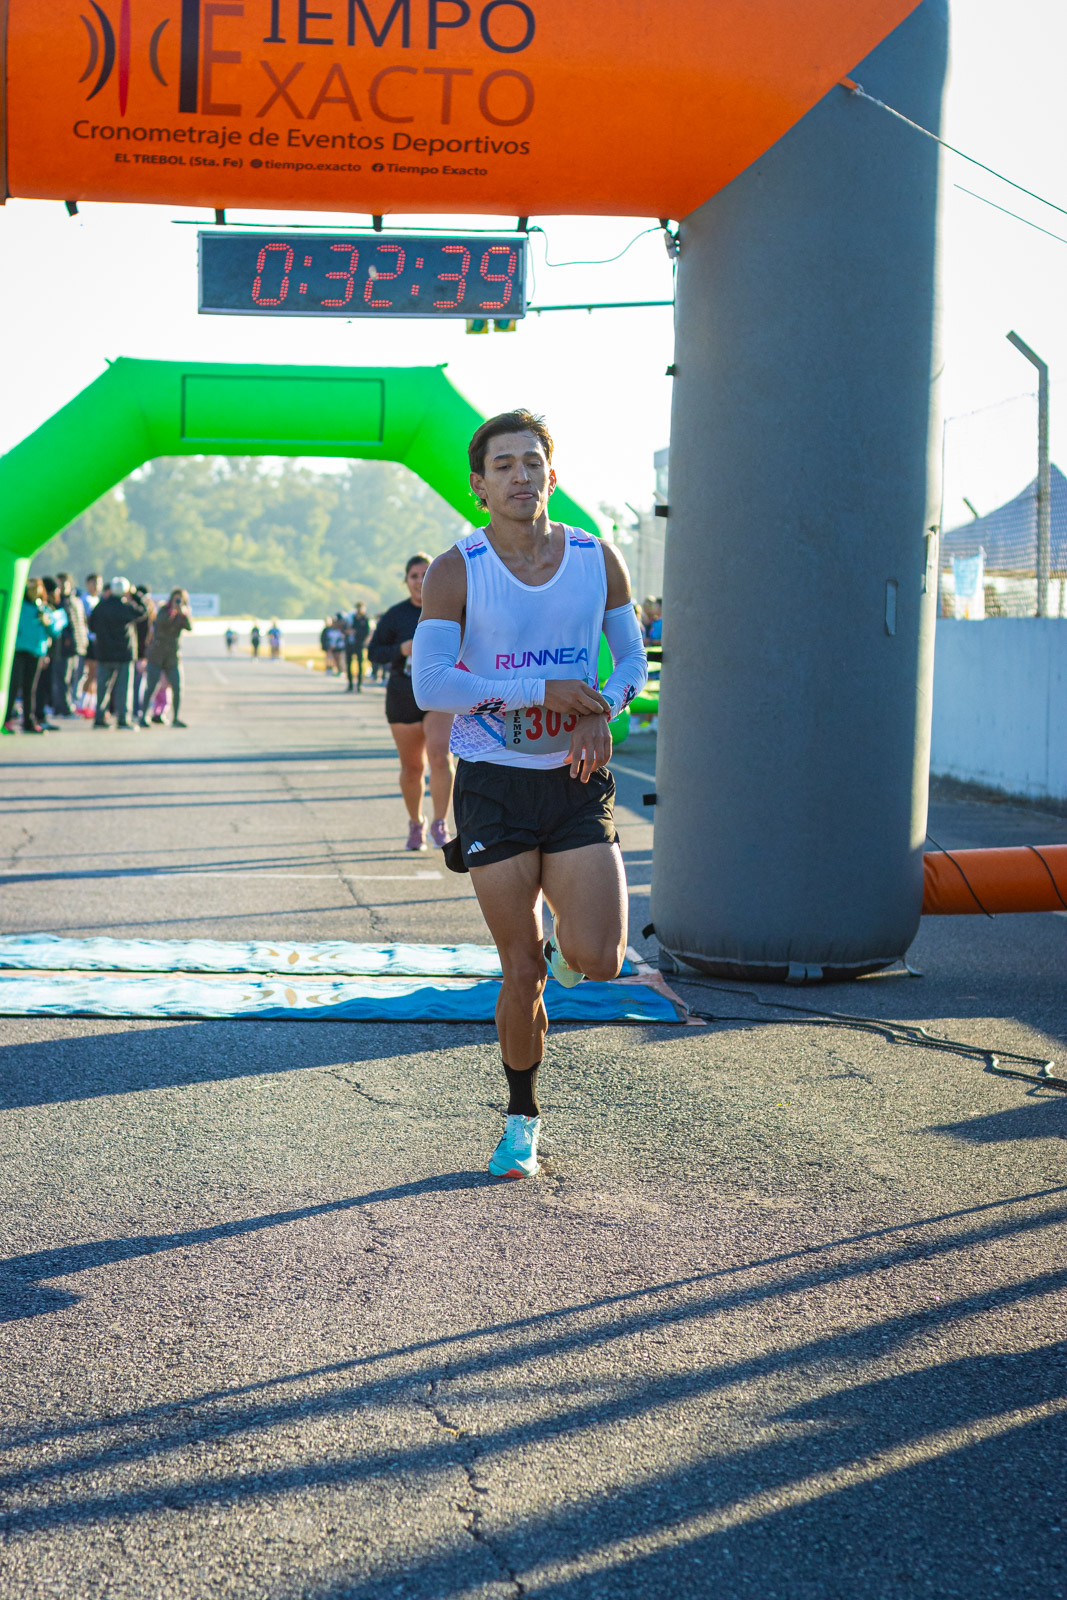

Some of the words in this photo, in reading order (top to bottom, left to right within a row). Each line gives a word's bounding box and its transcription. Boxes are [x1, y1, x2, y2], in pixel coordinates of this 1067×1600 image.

[73, 119, 242, 149] Cronometraje
[248, 126, 280, 147] de
[287, 129, 385, 150] Eventos
[392, 132, 531, 156] Deportivos
[114, 153, 131, 163] EL
[133, 154, 186, 165] TREBOL
[189, 156, 220, 168] (Sta.
[222, 157, 244, 169] Fe)
[264, 159, 362, 172] tiempo.exacto
[387, 163, 439, 176] Tiempo
[442, 165, 488, 176] Exacto
[251, 243, 518, 309] 0:32:39
[495, 647, 589, 670] RUNNEA
